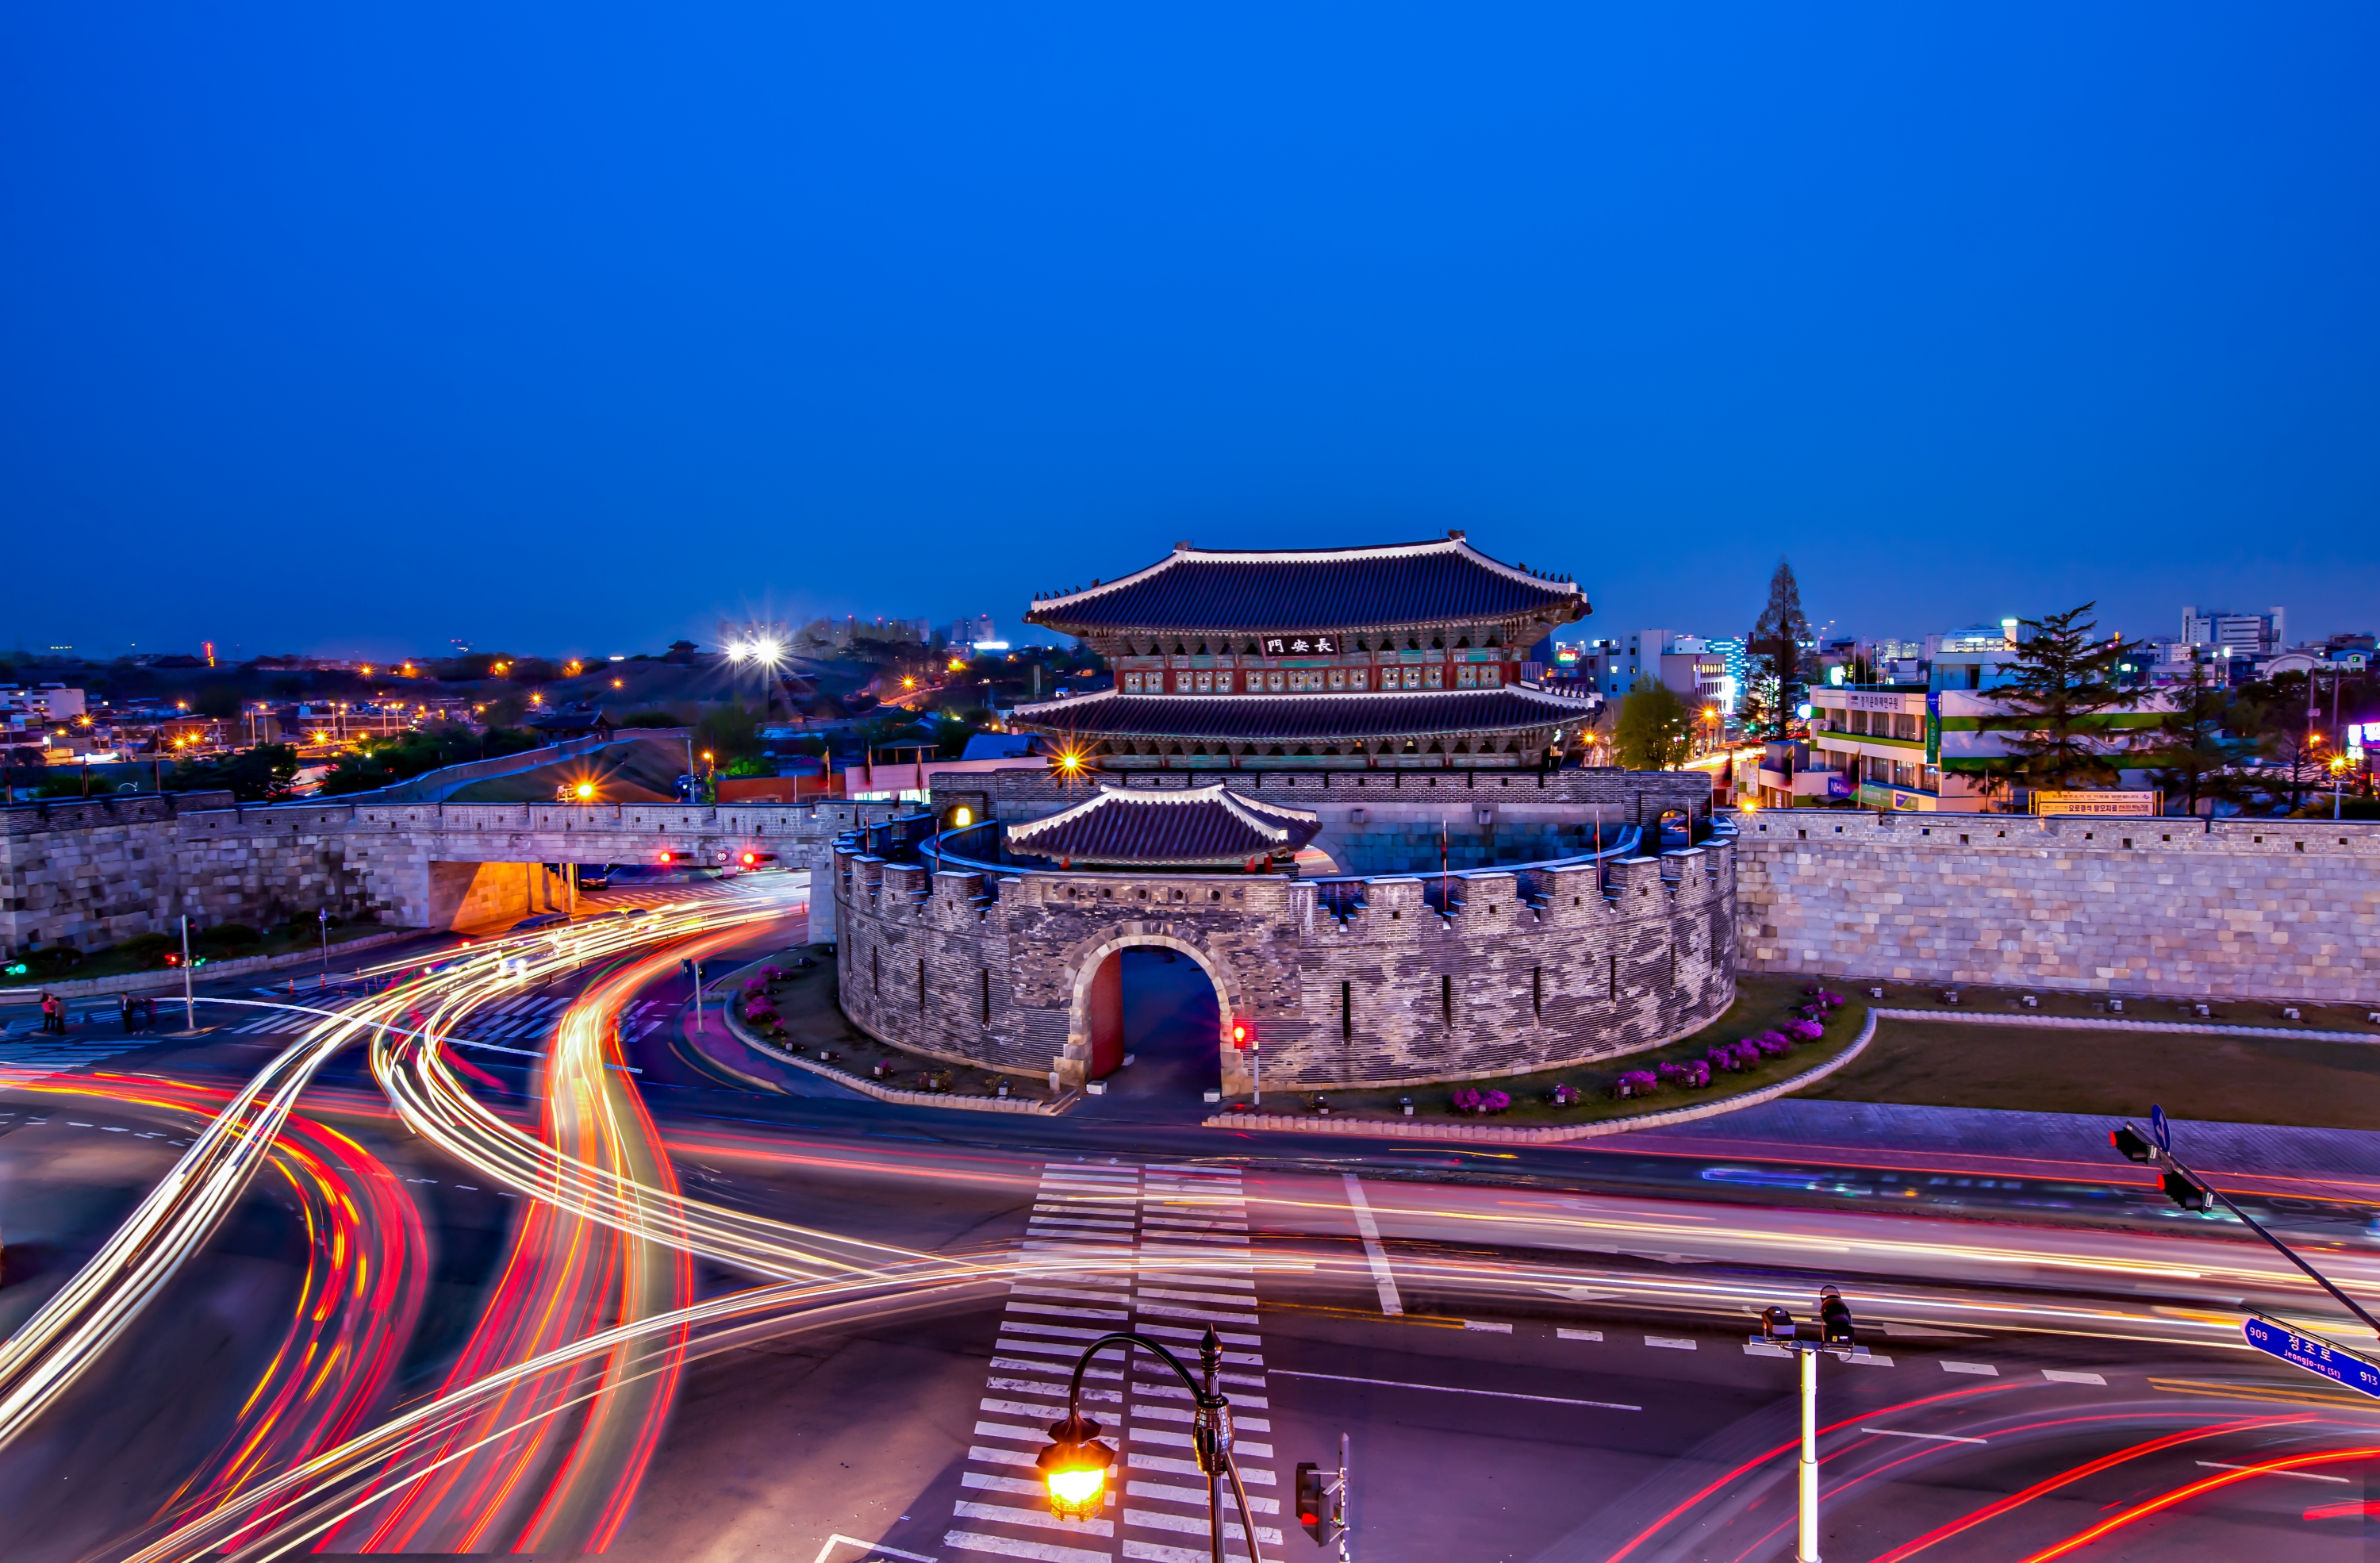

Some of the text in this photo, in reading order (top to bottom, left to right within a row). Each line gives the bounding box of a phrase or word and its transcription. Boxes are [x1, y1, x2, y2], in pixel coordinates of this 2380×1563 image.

[1860, 696, 1898, 709] 경기문화재연구원
[1830, 782, 1841, 793] NH
[2249, 1327, 2268, 1342] 909
[2288, 1335, 2332, 1362] 정조로
[2283, 1349, 2341, 1379] Jeongjo-ro (St)
[2360, 1371, 2378, 1386] 913
